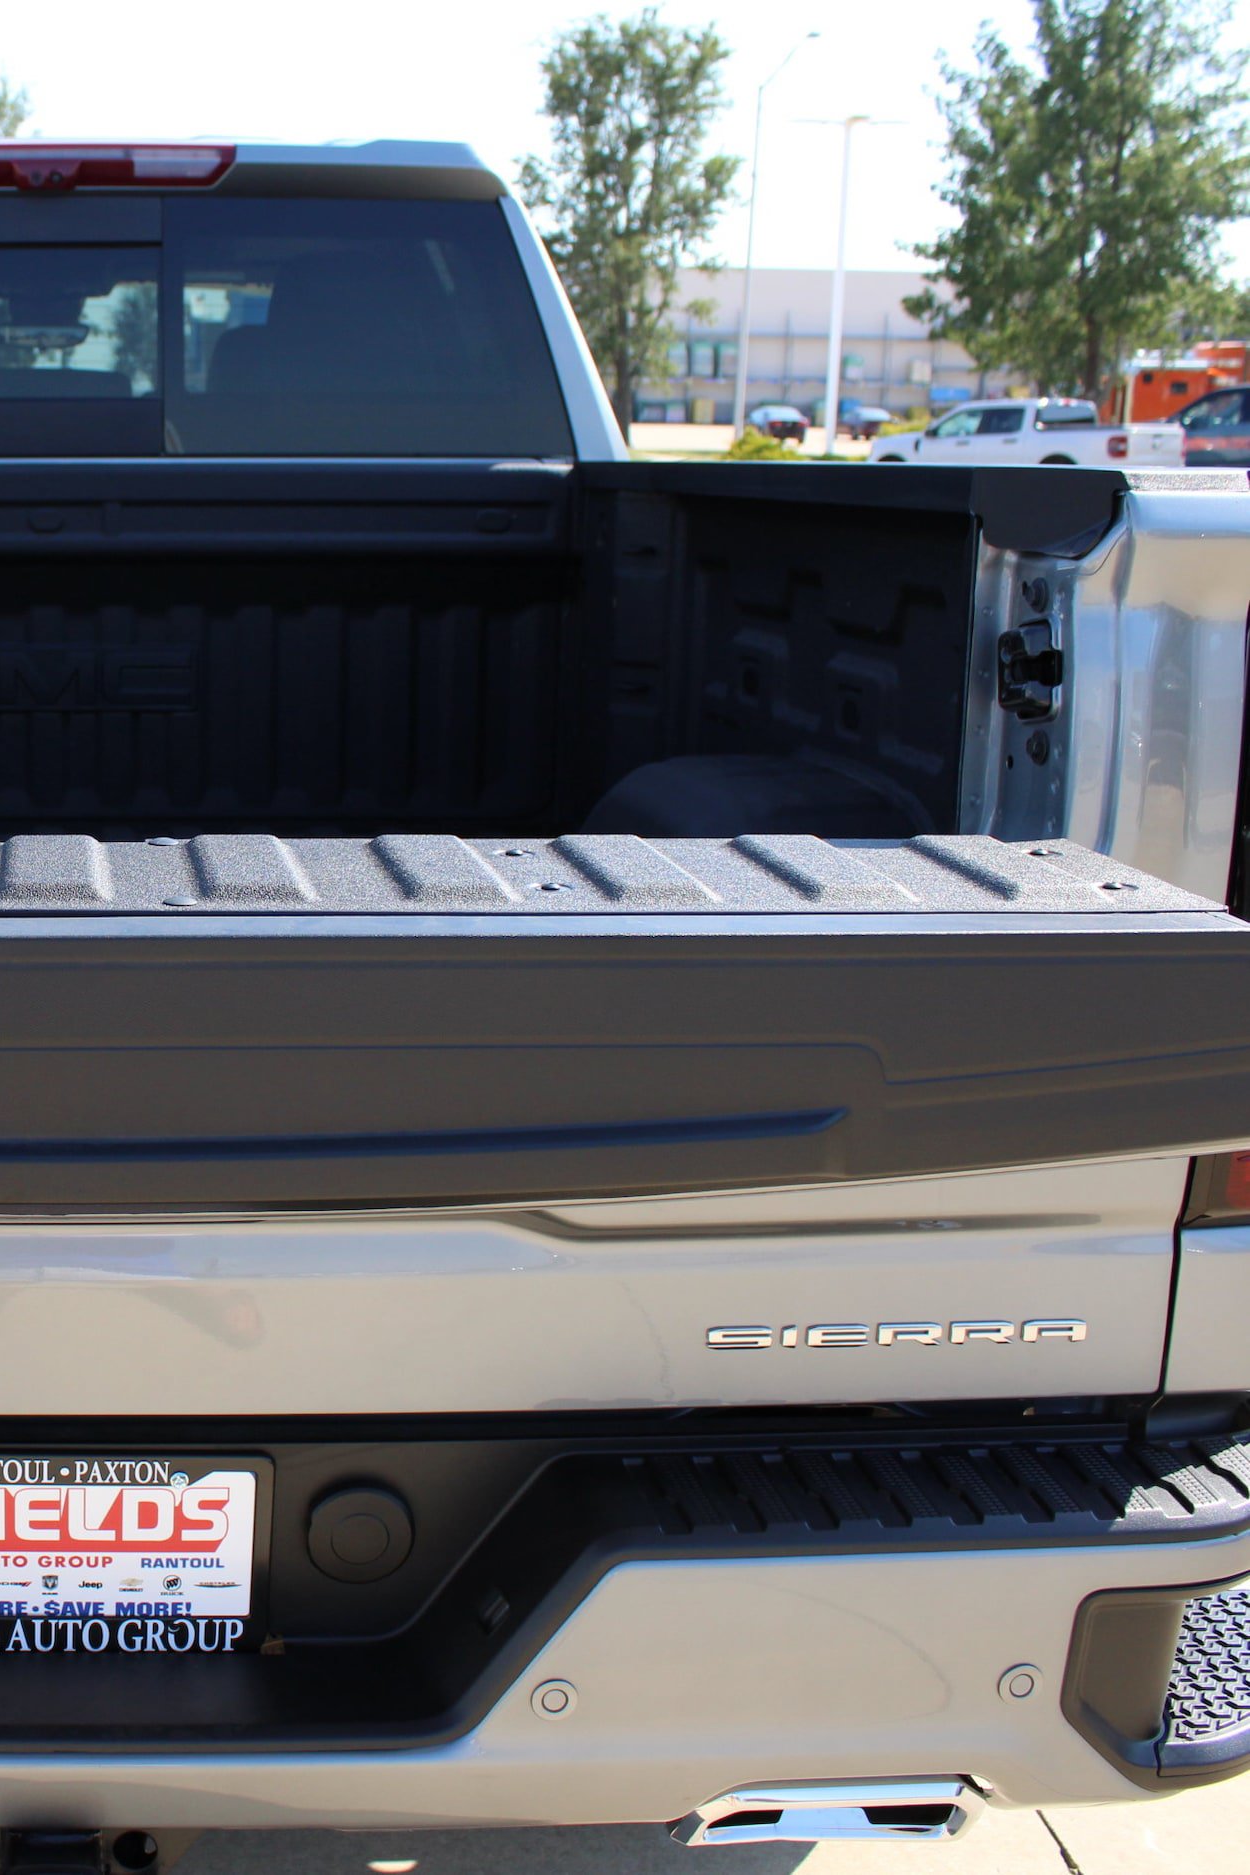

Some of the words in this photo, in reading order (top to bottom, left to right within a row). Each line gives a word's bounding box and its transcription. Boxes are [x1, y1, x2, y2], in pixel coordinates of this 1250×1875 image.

[706, 1318, 1087, 1349] SIERRA
[75, 1460, 171, 1485] PAXTON
[38, 1556, 113, 1568] GROUP
[141, 1558, 225, 1568] RANTOUL
[78, 1581, 103, 1589] Jeep
[115, 1602, 192, 1617] MORE!
[6, 1618, 110, 1652] AUTO
[117, 1618, 244, 1652] GROUP
